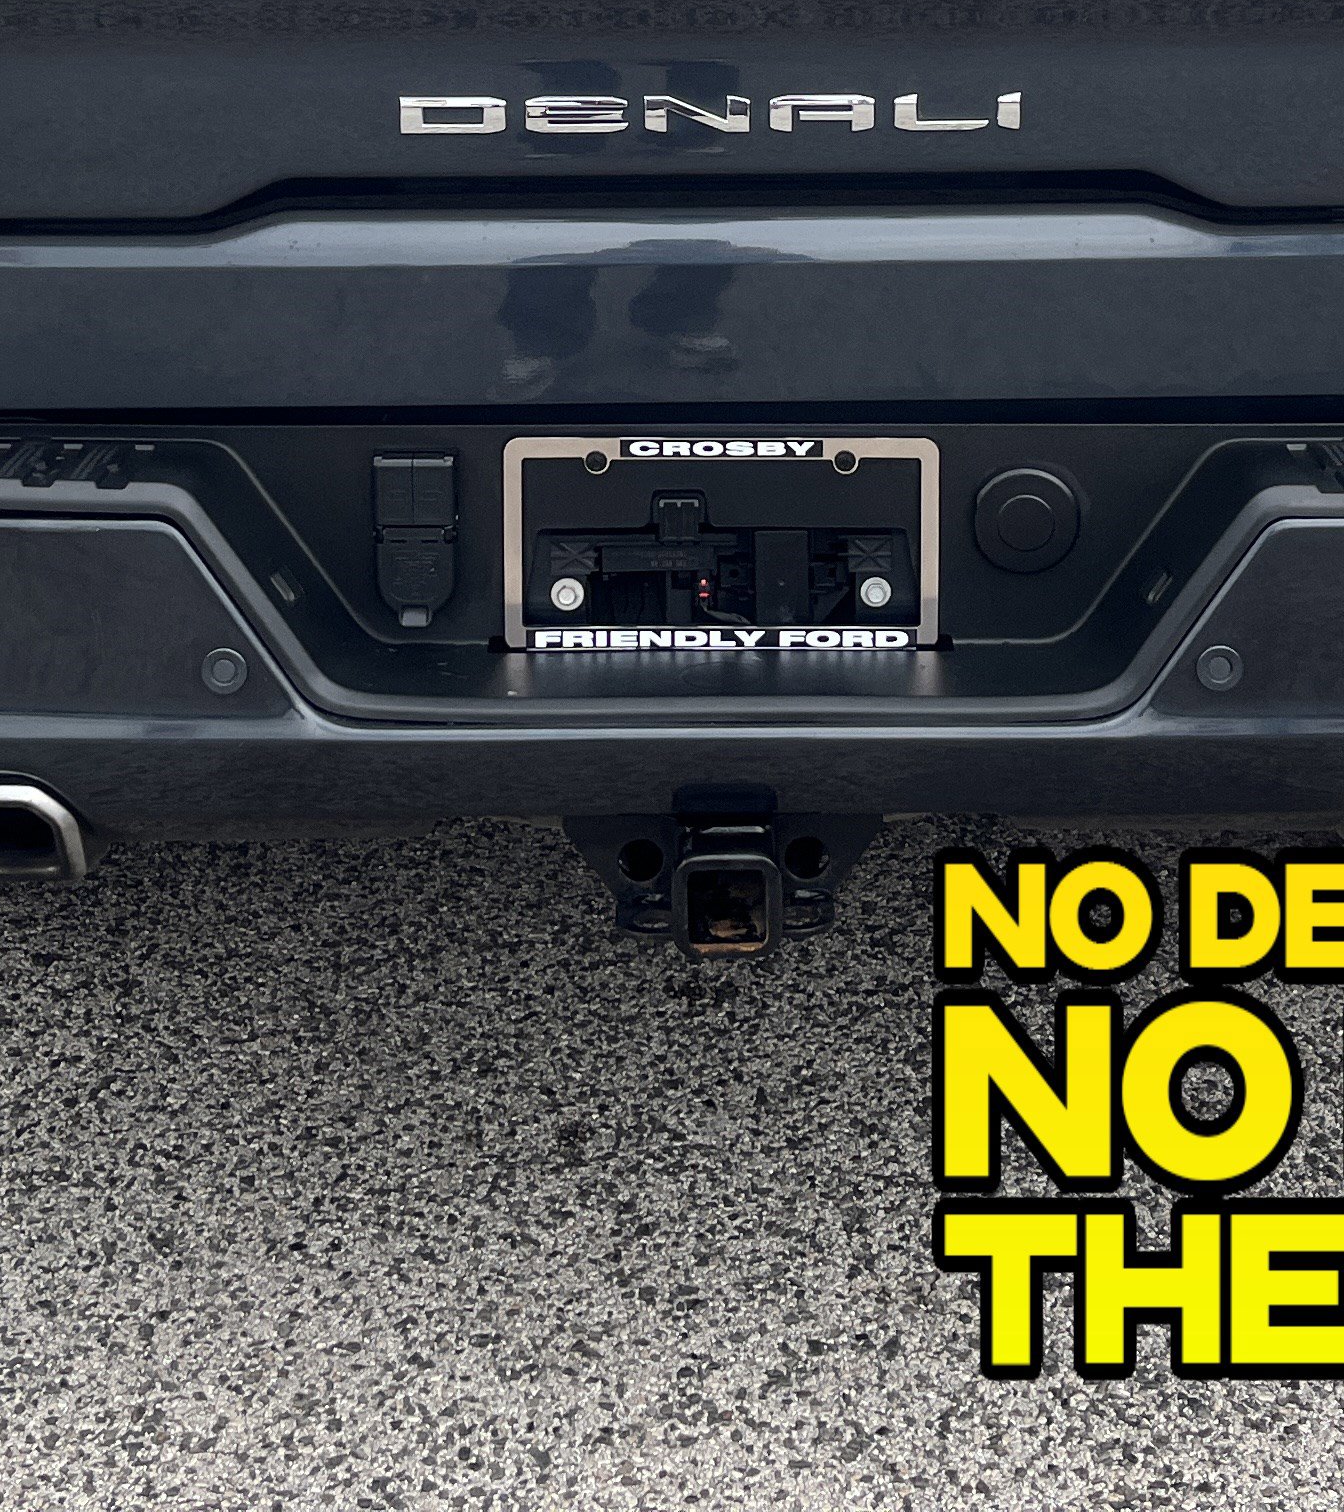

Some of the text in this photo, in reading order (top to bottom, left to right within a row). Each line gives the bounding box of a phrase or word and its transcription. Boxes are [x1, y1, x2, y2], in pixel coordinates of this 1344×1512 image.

[399, 92, 1021, 135] DENALI
[628, 440, 816, 457] CROSBY
[533, 630, 910, 648] FRIENDLY FORD
